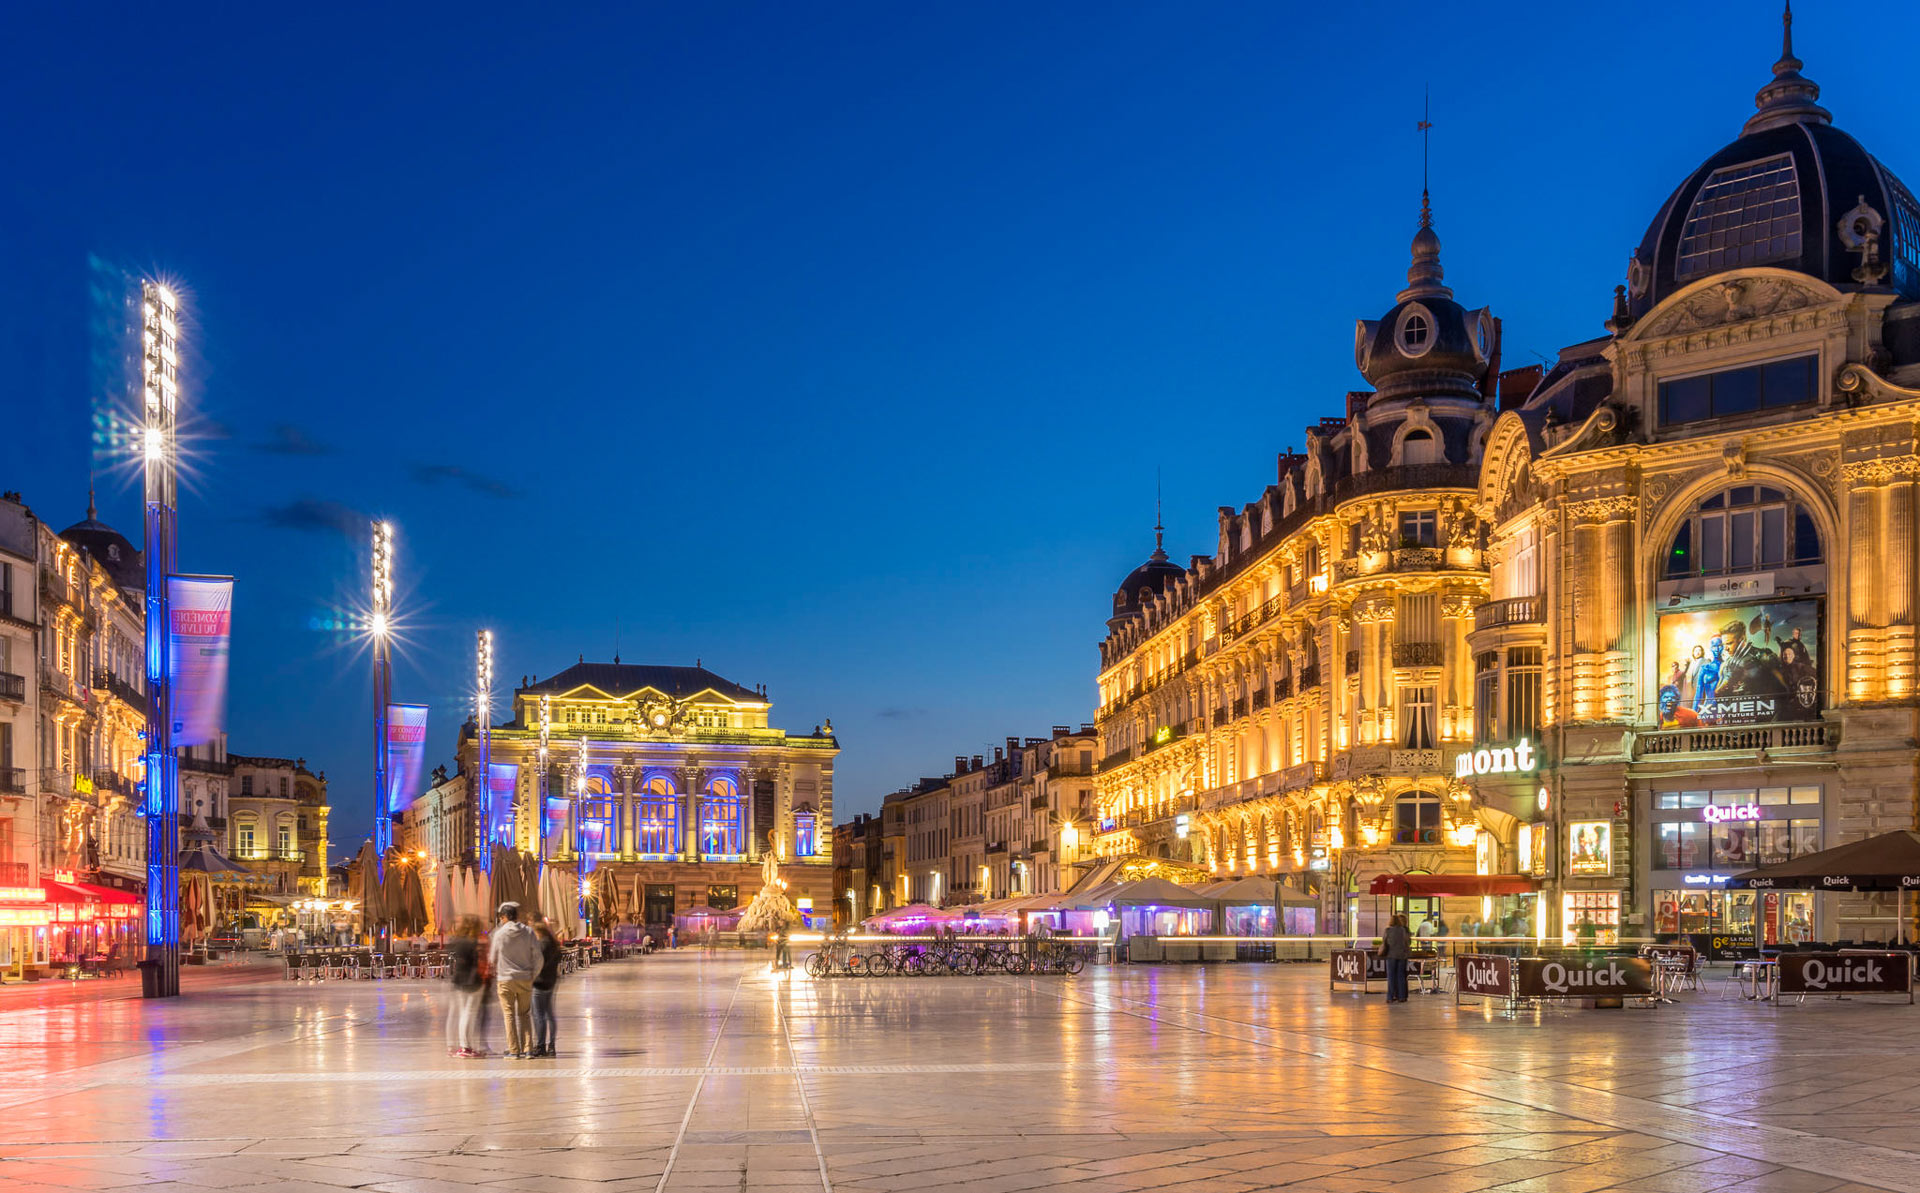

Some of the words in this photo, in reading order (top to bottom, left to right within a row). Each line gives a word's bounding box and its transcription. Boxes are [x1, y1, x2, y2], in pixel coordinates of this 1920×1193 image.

[1698, 699, 1775, 715] X-MEN
[1703, 803, 1760, 823] Quick
[1713, 824, 1817, 861] Quick
[1750, 878, 1774, 888] Quick
[1823, 876, 1849, 886] Quick
[1902, 876, 1920, 886] Qui
[1767, 894, 1777, 904] Q
[1661, 903, 1675, 919] Q
[1713, 936, 1729, 949] 6€
[1337, 955, 1359, 978] Quick
[1802, 959, 1884, 989] Quick
[1466, 961, 1500, 990] Quick
[1541, 962, 1627, 993] Quick
